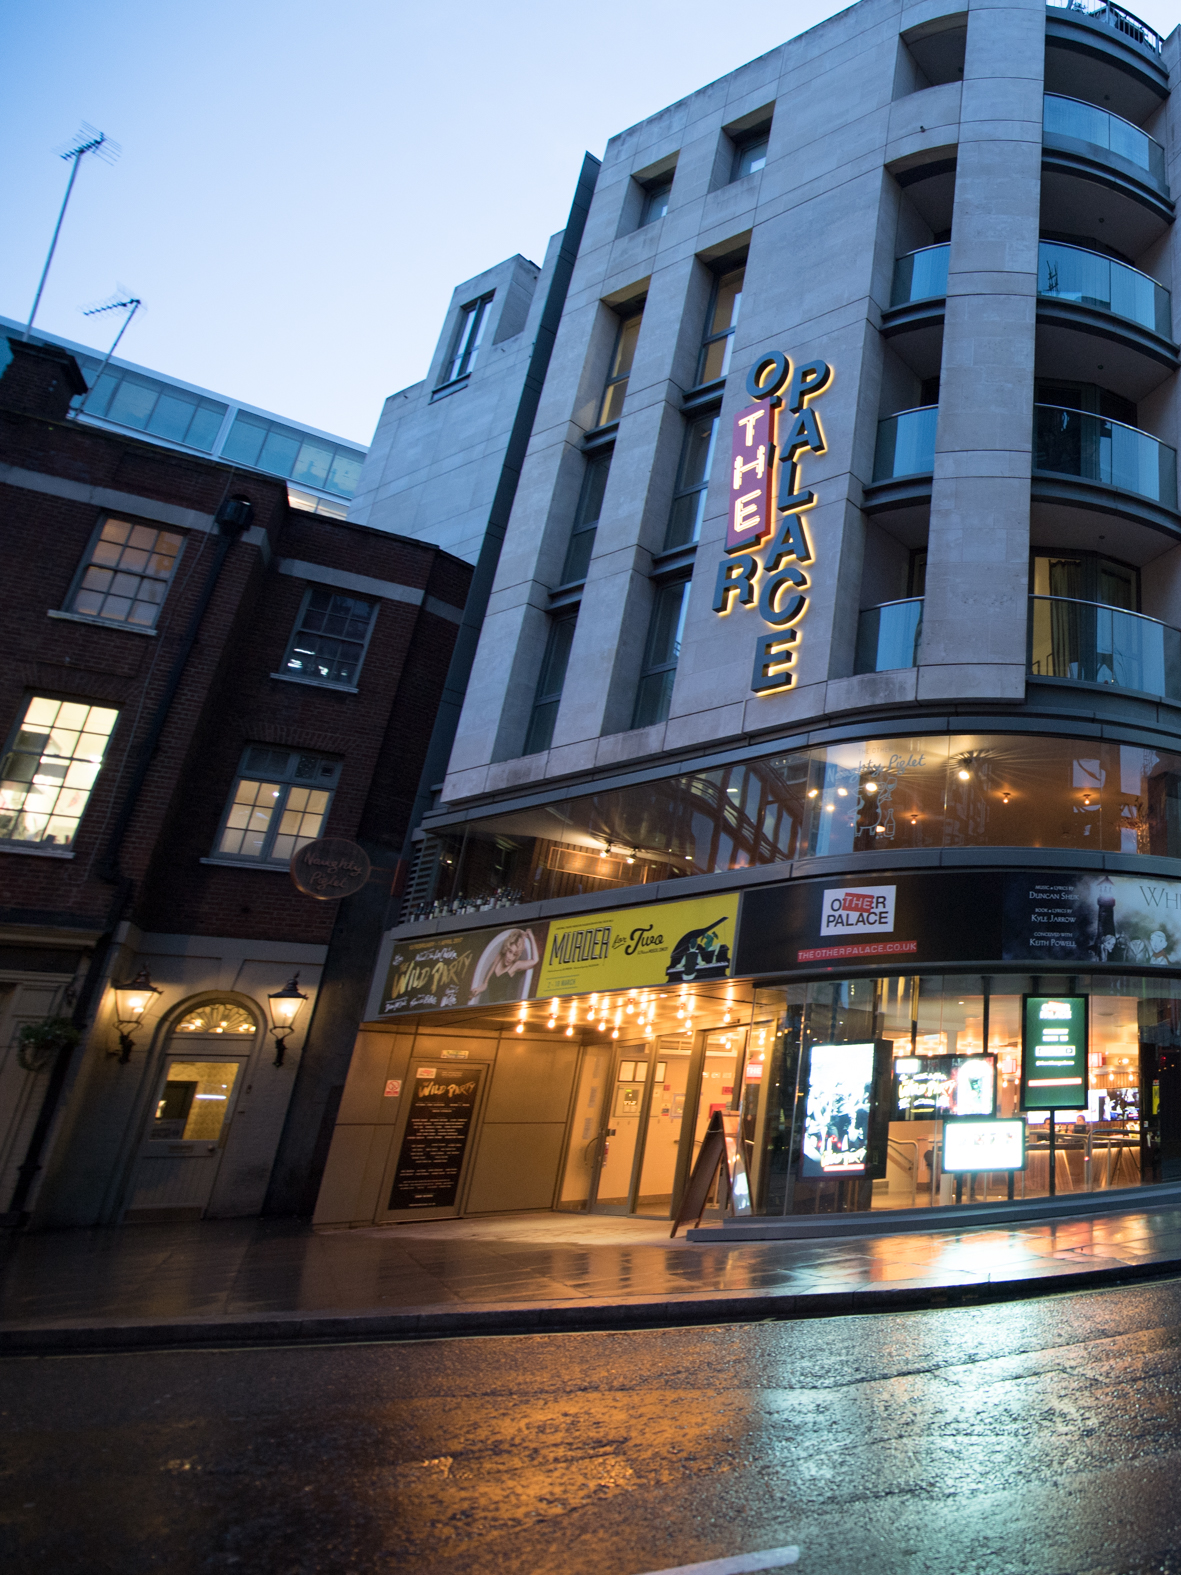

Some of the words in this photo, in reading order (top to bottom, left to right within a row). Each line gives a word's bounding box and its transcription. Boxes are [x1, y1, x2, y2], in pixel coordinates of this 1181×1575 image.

[751, 358, 834, 696] PALACE
[888, 754, 926, 776] Piglet
[304, 852, 362, 877] Naughty
[309, 871, 347, 890] Piglet
[1029, 891, 1060, 900] DUNCAN
[826, 911, 889, 928] PALACE
[1031, 914, 1048, 923] KYLE
[1049, 914, 1077, 923] JARROW
[549, 926, 612, 966] MURDER
[612, 934, 627, 949] for
[625, 924, 665, 956] Two
[1029, 938, 1049, 946] KEITH
[1050, 939, 1077, 947] POWELL
[391, 960, 431, 999] WILD
[431, 950, 474, 994] PARTY
[746, 1066, 762, 1075] THE
[418, 1081, 446, 1098] WILD
[447, 1081, 477, 1098] PARTY
